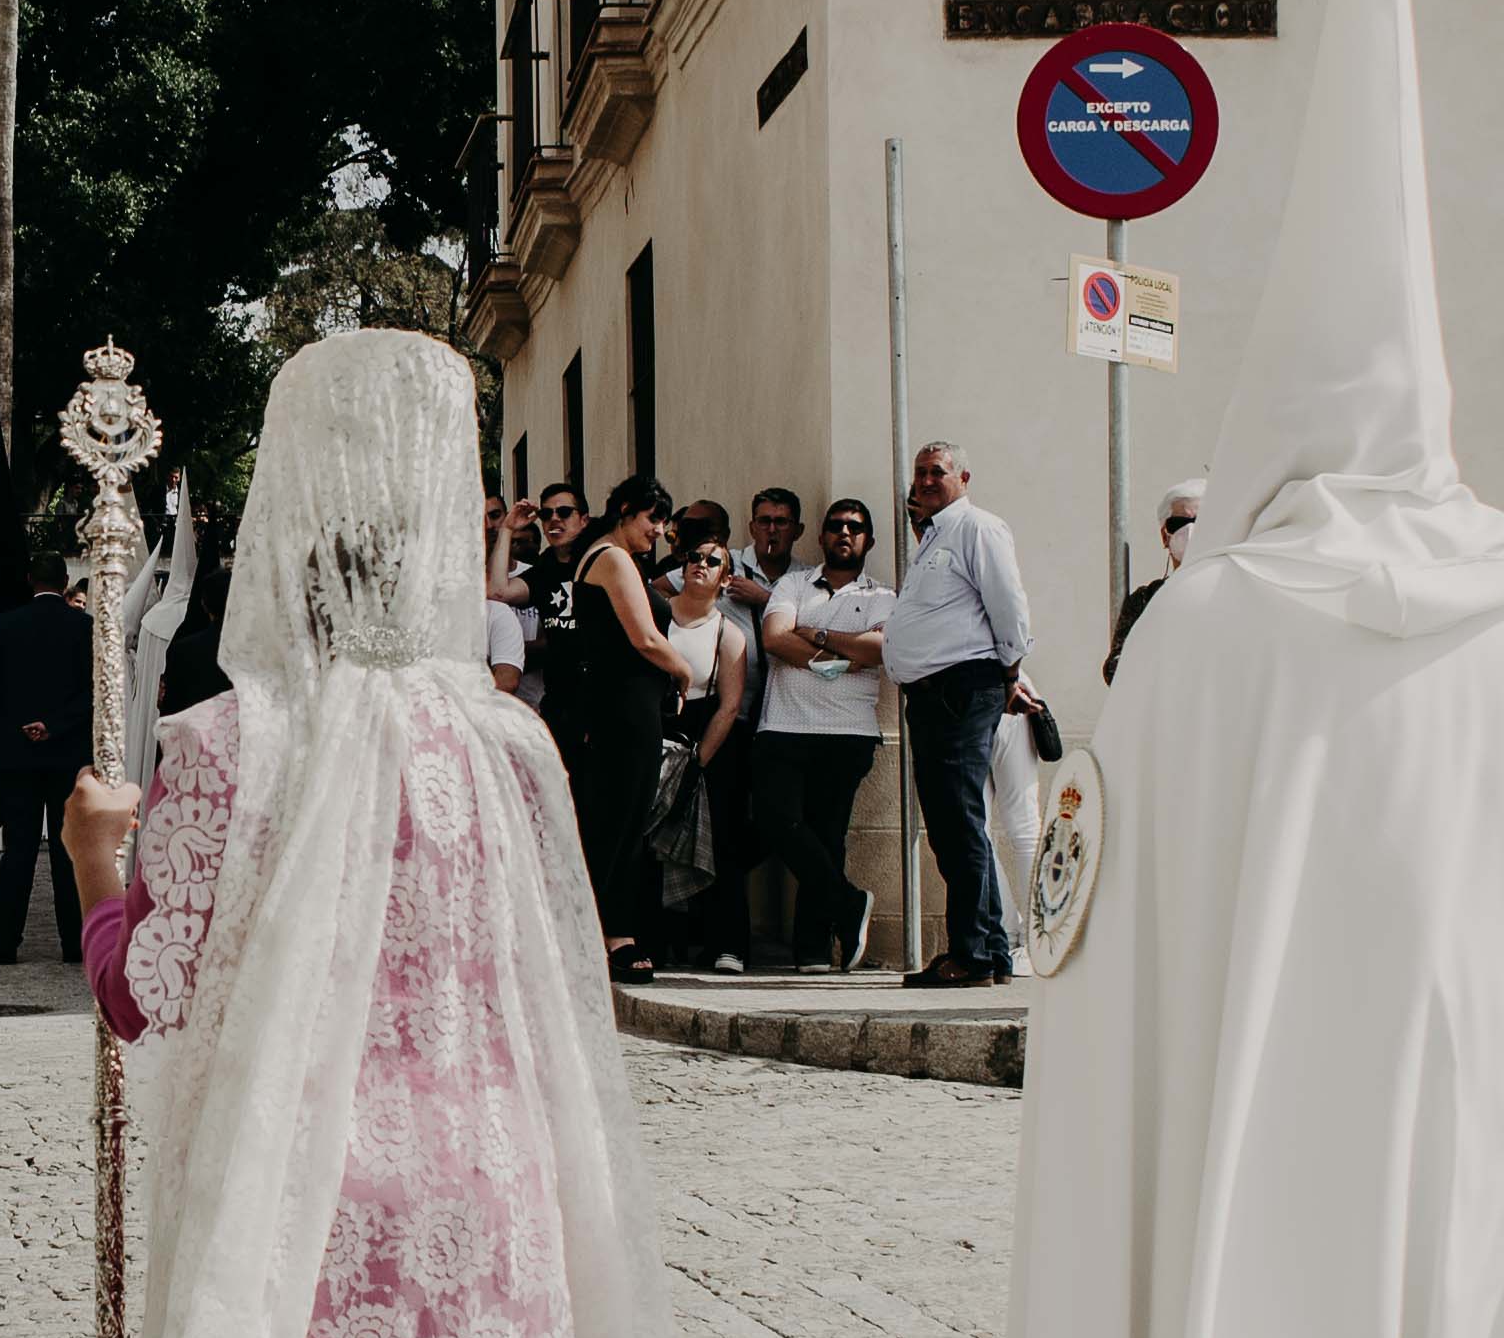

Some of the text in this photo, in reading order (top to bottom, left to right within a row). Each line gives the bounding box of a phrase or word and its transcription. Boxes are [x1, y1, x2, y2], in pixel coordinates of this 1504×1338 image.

[1086, 101, 1151, 114] EXCEPTO
[1048, 119, 1190, 133] CARGA Y DESCARGA
[1154, 279, 1173, 293] LOCAL
